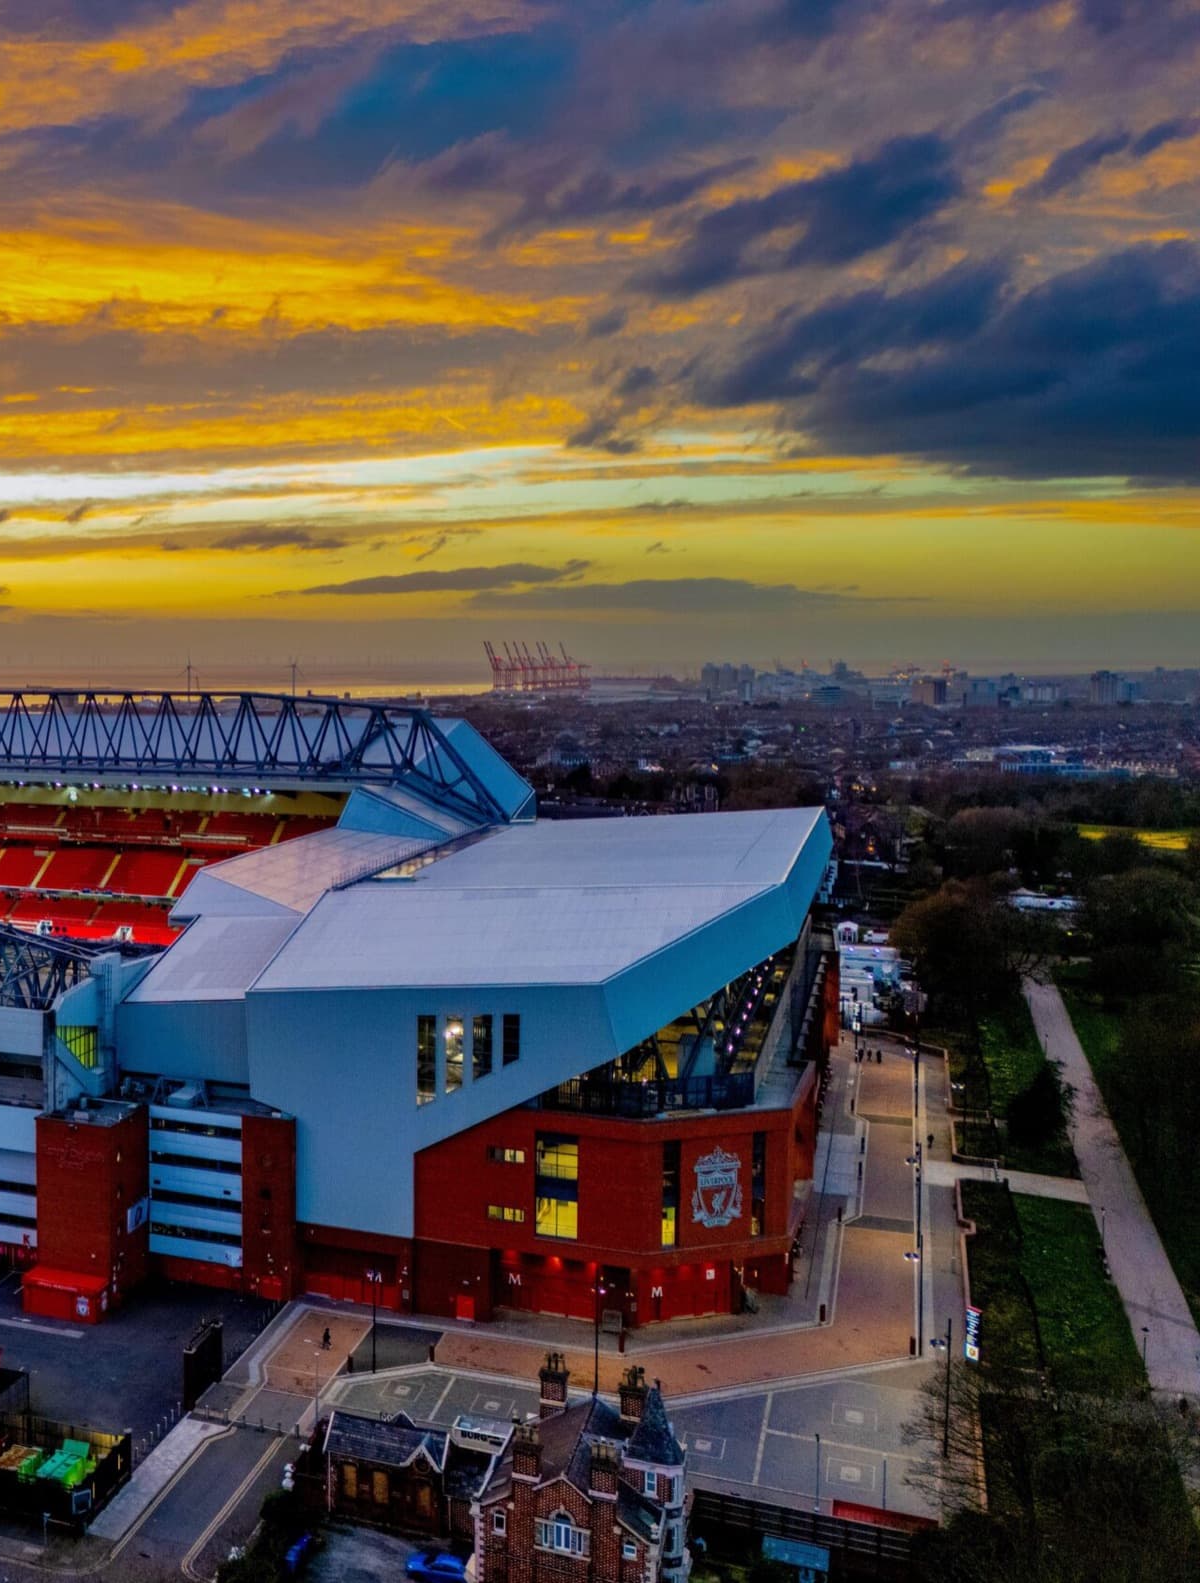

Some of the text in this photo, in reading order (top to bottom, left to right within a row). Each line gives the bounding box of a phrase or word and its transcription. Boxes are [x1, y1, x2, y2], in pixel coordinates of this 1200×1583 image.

[700, 1176, 733, 1186] LIVERPOOL
[23, 1233, 30, 1245] K
[508, 1272, 522, 1286] M
[651, 1286, 664, 1299] M
